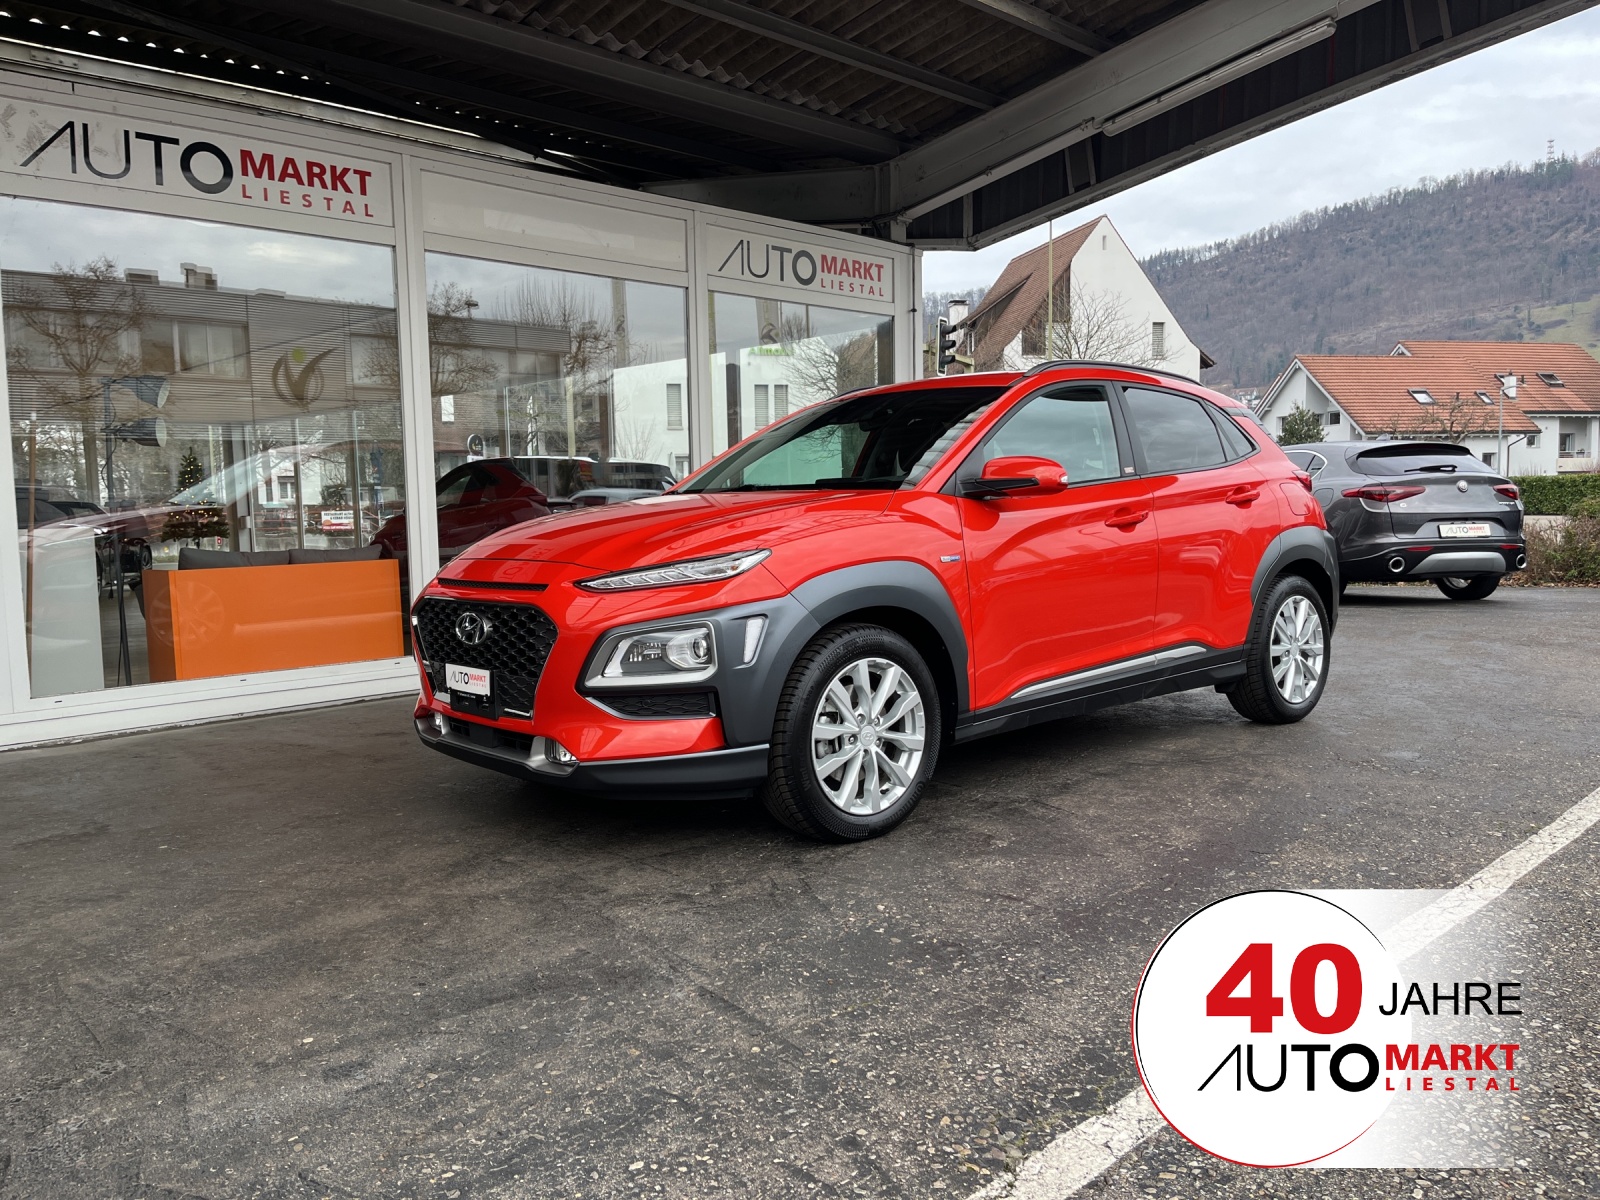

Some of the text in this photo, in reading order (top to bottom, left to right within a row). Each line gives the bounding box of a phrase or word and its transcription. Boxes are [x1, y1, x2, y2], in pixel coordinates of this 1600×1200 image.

[239, 148, 372, 196] MARKT
[241, 184, 374, 218] LIESTAL
[820, 254, 885, 283] MARKT
[820, 277, 885, 297] LIESTAL
